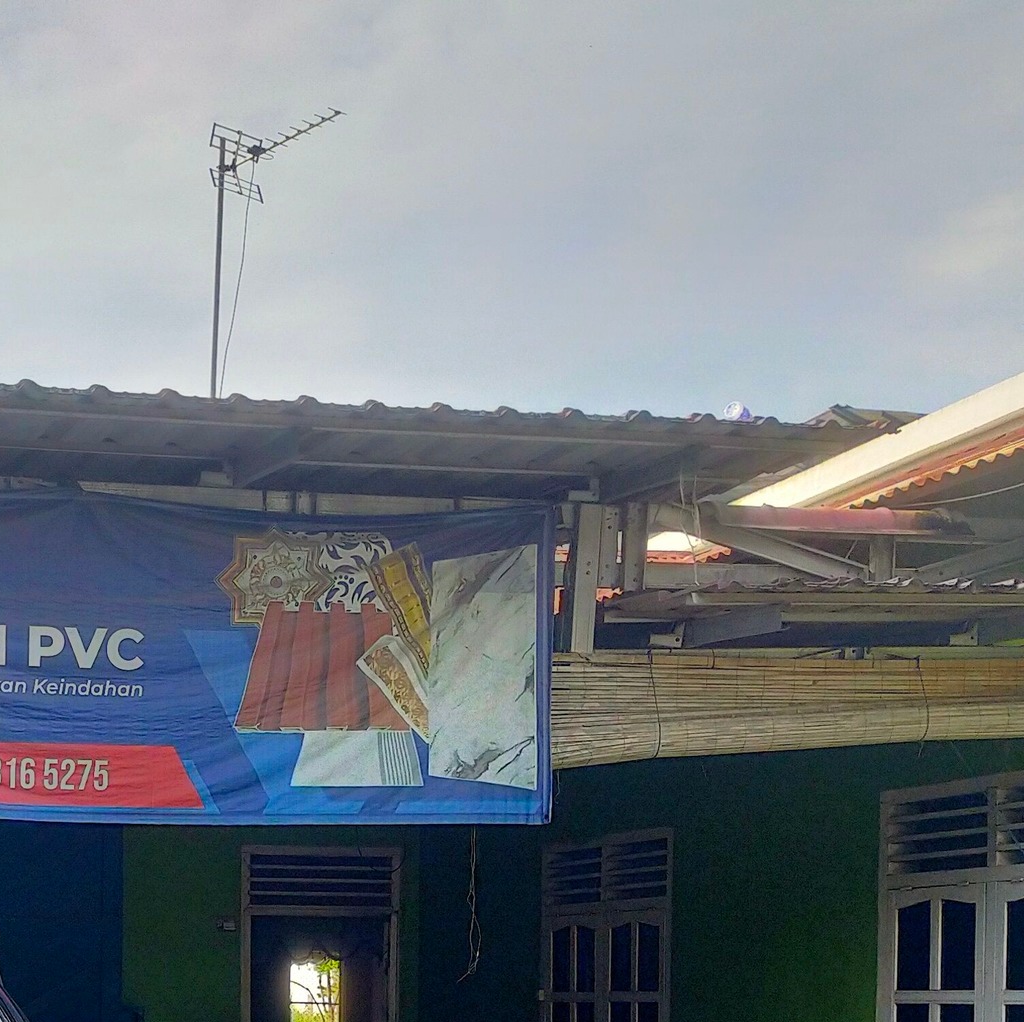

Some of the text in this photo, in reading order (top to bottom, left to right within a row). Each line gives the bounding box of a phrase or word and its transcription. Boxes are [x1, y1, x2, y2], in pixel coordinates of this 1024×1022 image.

[28, 625, 145, 671] PVC
[33, 678, 144, 697] Keindahan
[43, 758, 109, 791] 5275
